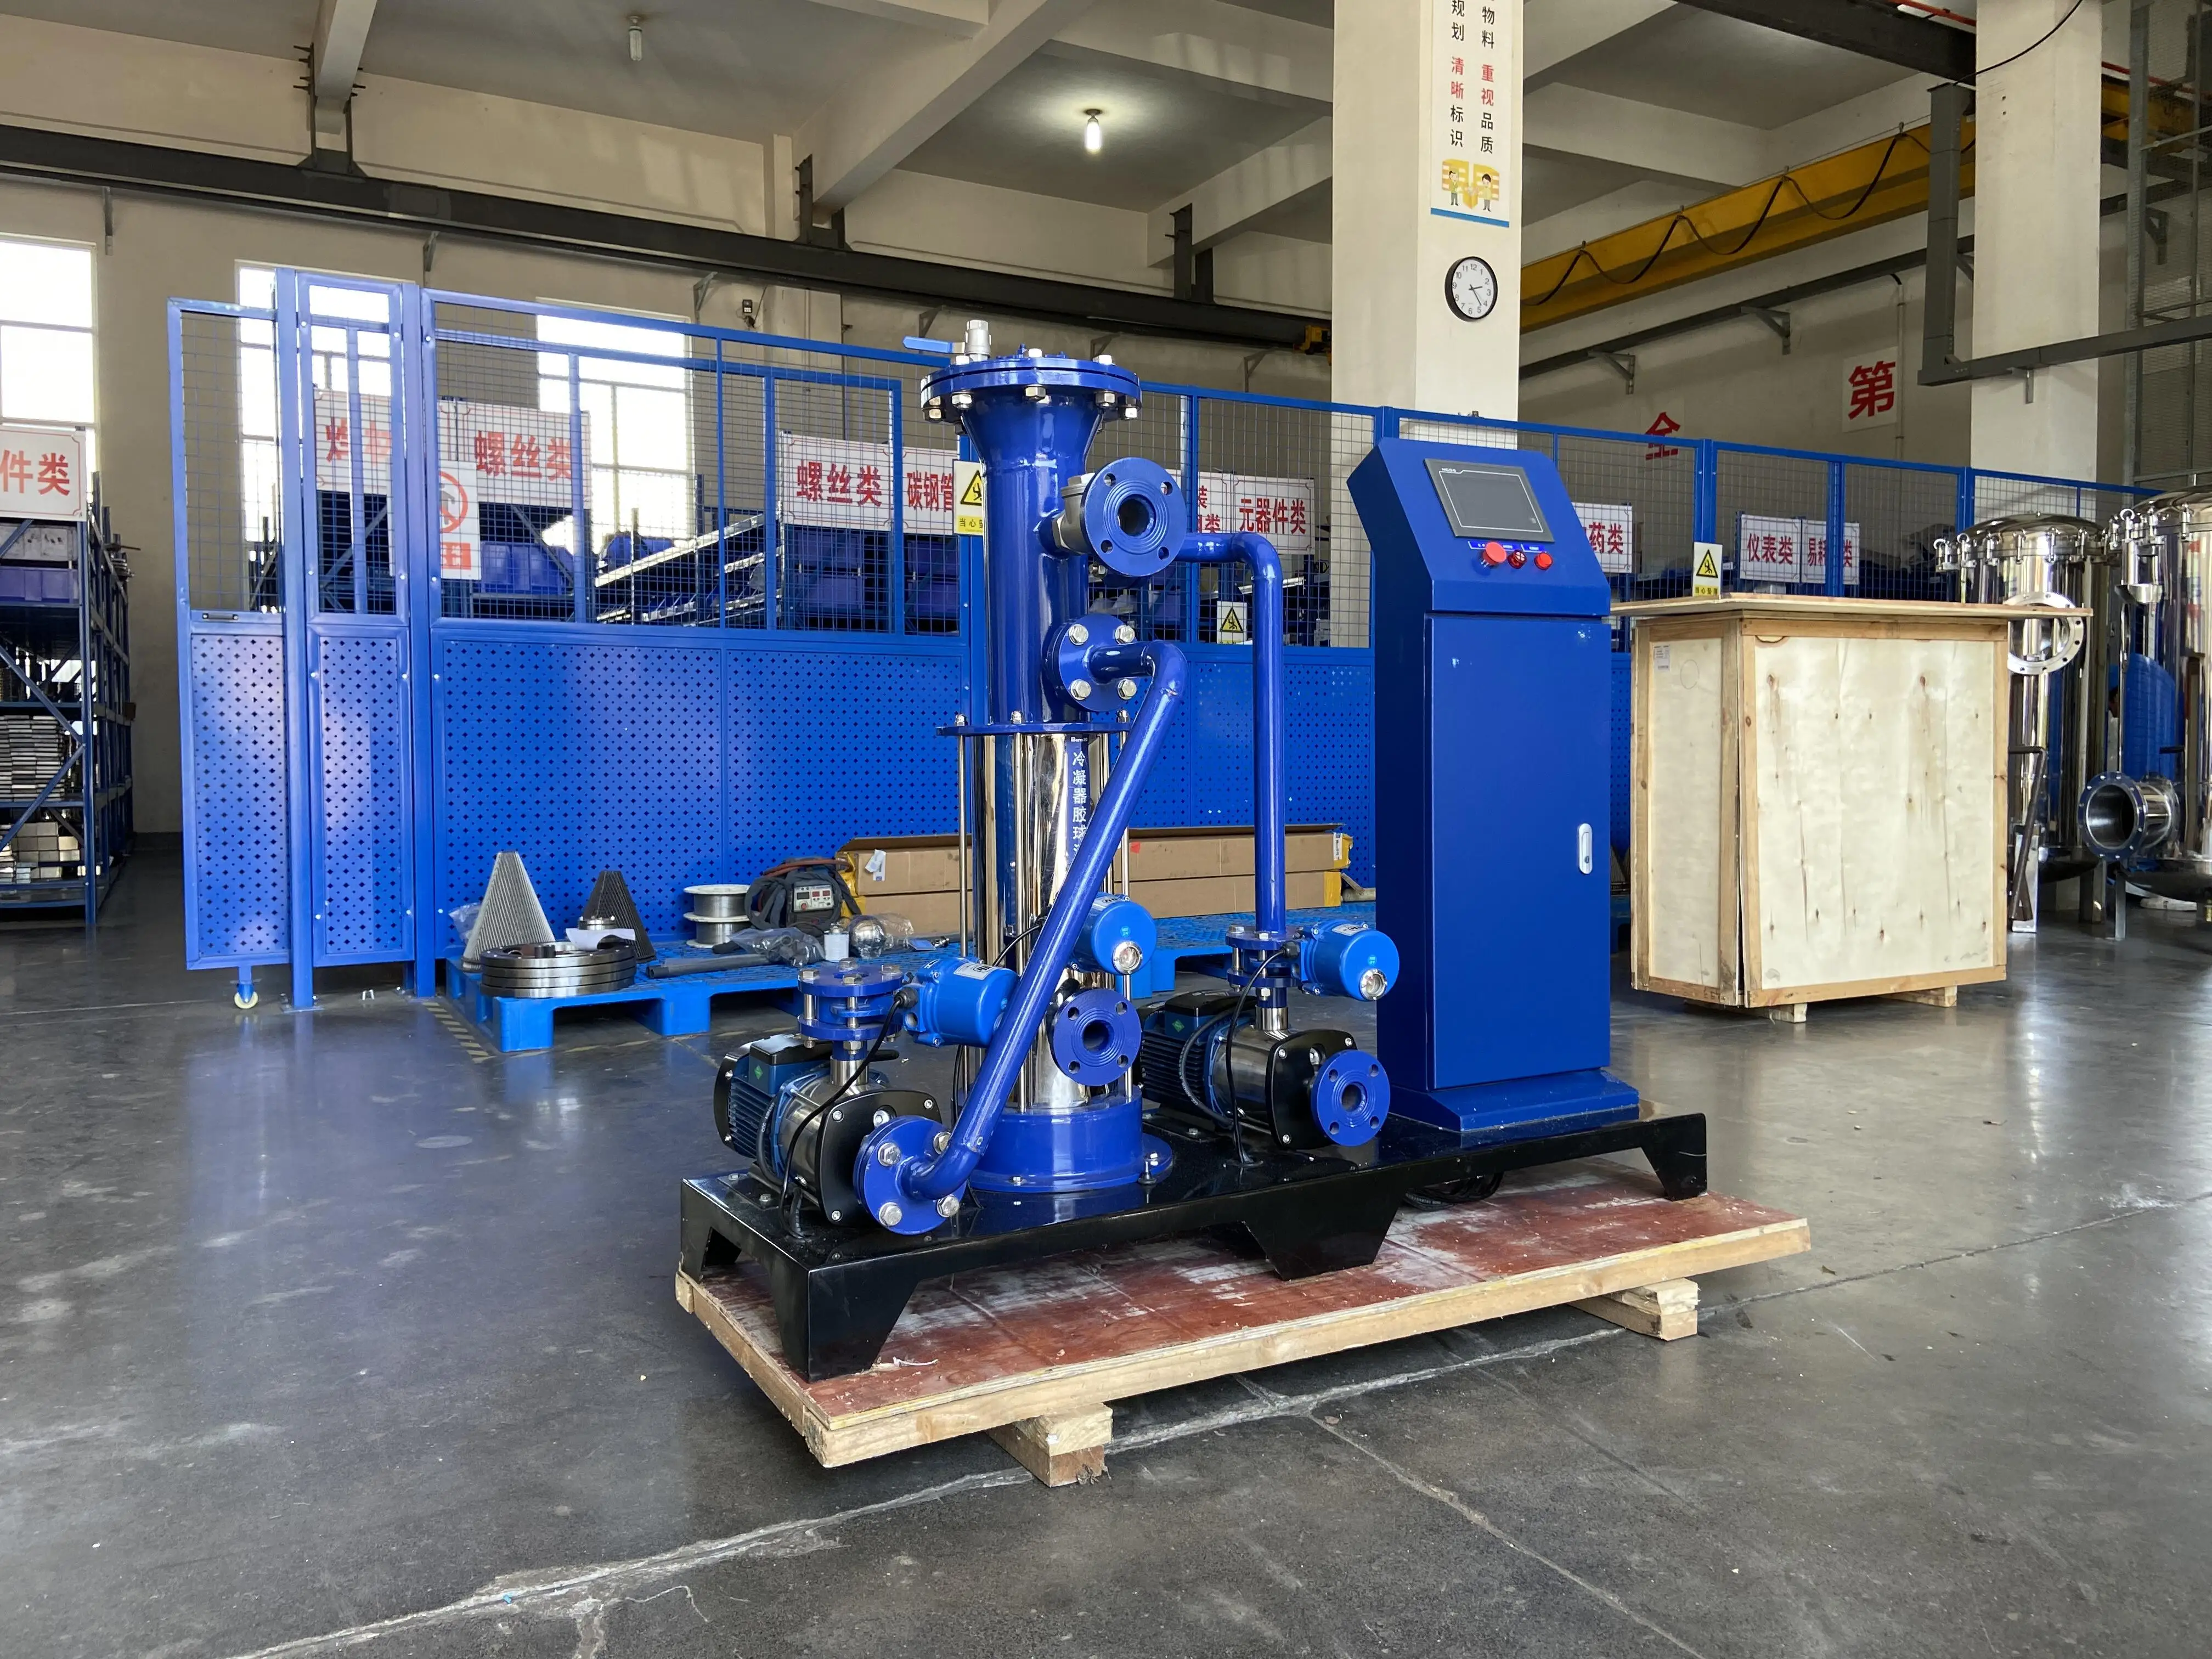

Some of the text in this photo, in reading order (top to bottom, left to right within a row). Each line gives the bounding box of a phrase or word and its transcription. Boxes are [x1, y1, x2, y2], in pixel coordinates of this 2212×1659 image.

[1450, 0, 1465, 148] 规划 清晰标识
[1480, 0, 1496, 154] 物料 重视品质
[1848, 360, 1896, 421] 第
[0, 449, 70, 496] 件类
[474, 431, 572, 481] 螺丝类
[796, 460, 882, 507] 螺丝类
[906, 470, 953, 512] 碳钢管
[1239, 498, 1306, 535] 元器件类
[1582, 522, 1623, 555] 药类
[1747, 533, 1793, 565] 仪表类
[1072, 751, 1088, 851] 冷凝器胶球
